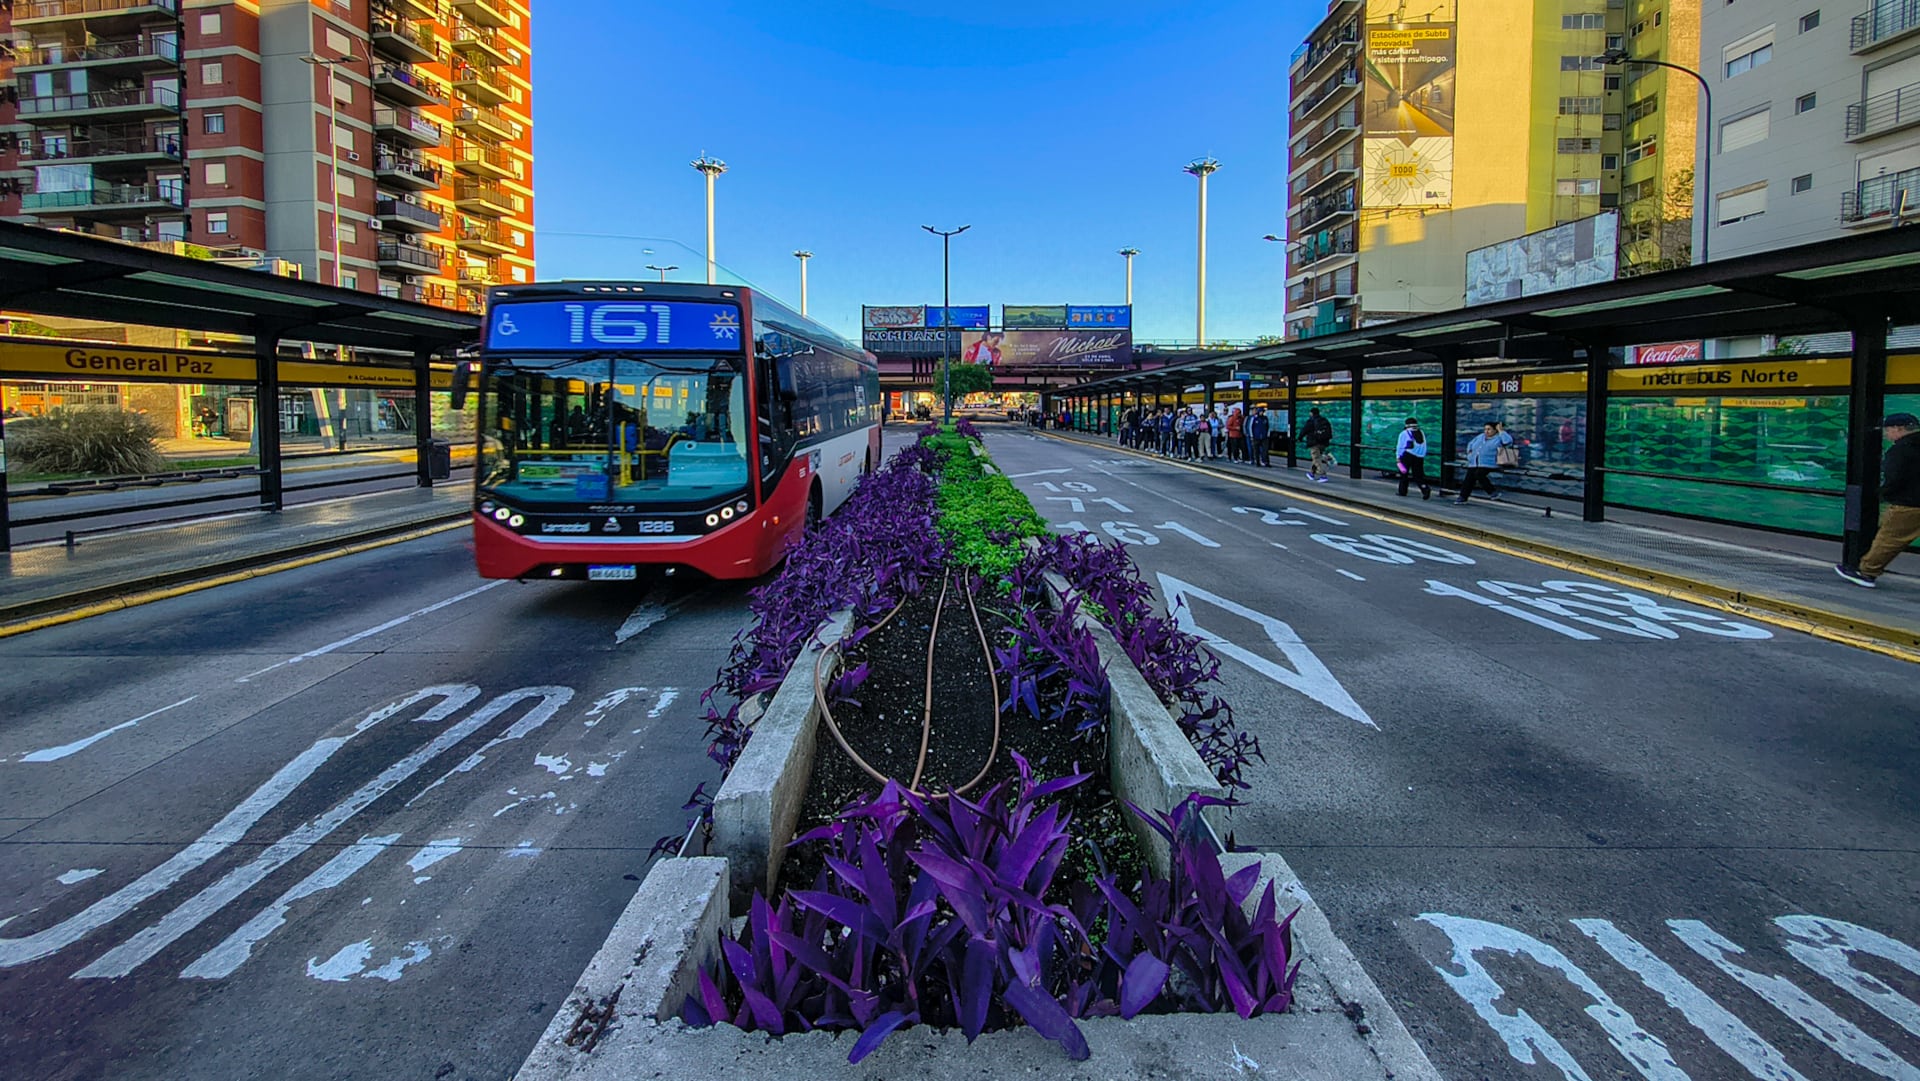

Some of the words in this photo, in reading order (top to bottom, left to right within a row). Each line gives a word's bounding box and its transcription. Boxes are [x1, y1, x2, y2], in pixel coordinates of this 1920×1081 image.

[1371, 31, 1412, 39] Estaciones
[1425, 30, 1447, 38] Subte
[564, 304, 671, 343] 161
[1049, 333, 1126, 357] Michael
[65, 349, 168, 373] General
[175, 355, 213, 374] Paz
[1741, 368, 1798, 384] Norte
[1459, 382, 1470, 393] 21
[1480, 381, 1492, 393] 60
[1501, 380, 1519, 393] 168
[1033, 481, 1097, 493] 19
[1045, 497, 1134, 513] 71
[1231, 507, 1350, 526] 21
[638, 521, 675, 533] 1286
[1055, 521, 1222, 548] 161
[1310, 533, 1476, 565] 60
[1423, 579, 1775, 641] 168
